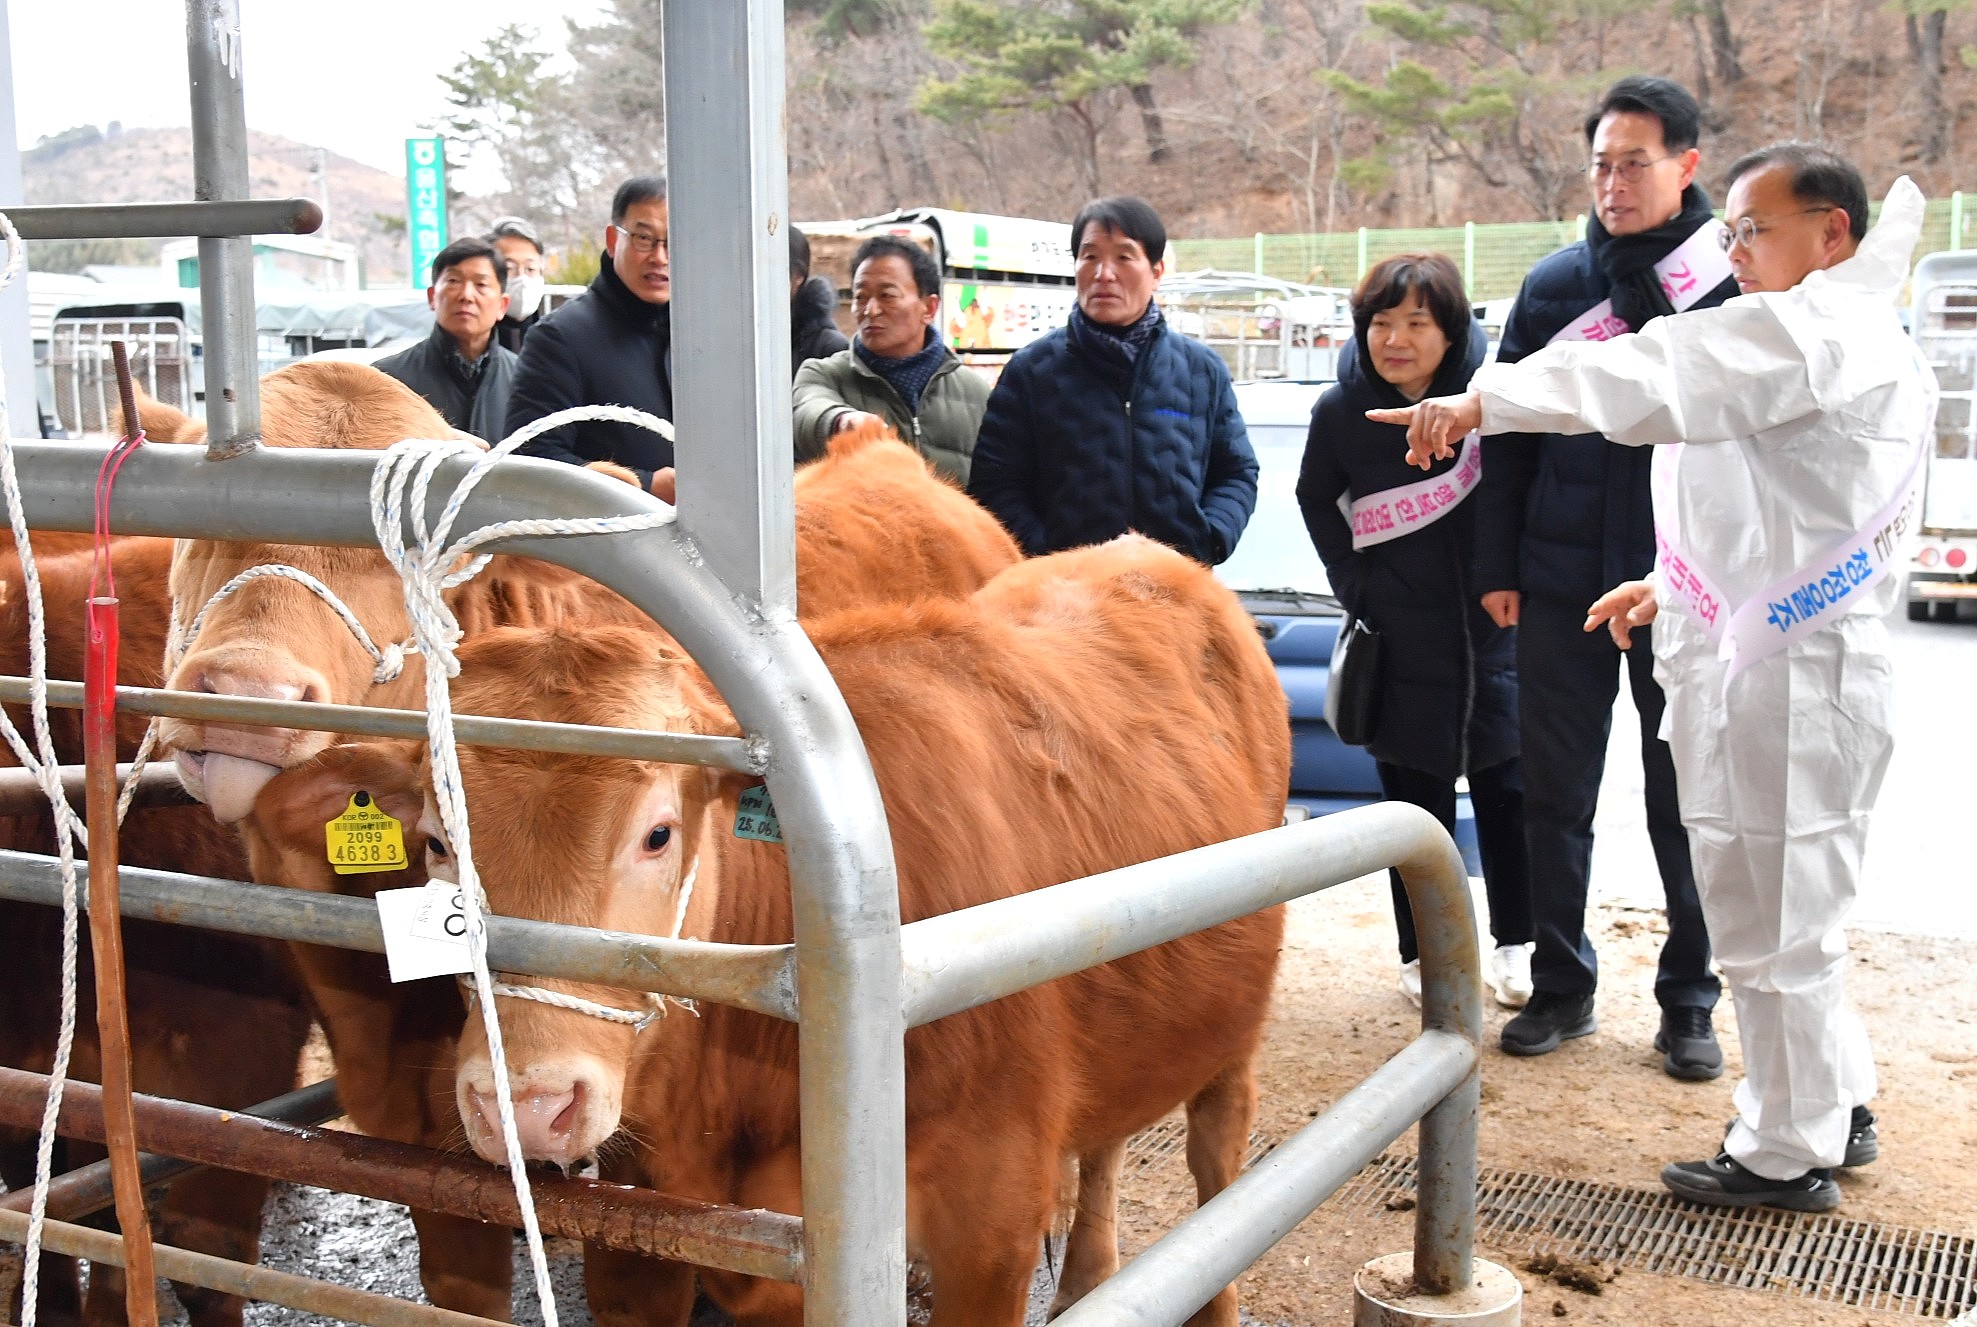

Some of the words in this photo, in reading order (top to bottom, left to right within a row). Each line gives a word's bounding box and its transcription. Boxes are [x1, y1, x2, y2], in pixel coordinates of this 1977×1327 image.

[1767, 547, 1874, 633] 청정울주
[347, 832, 382, 843] 2099
[336, 845, 380, 861] 4638
[387, 844, 396, 860] 3
